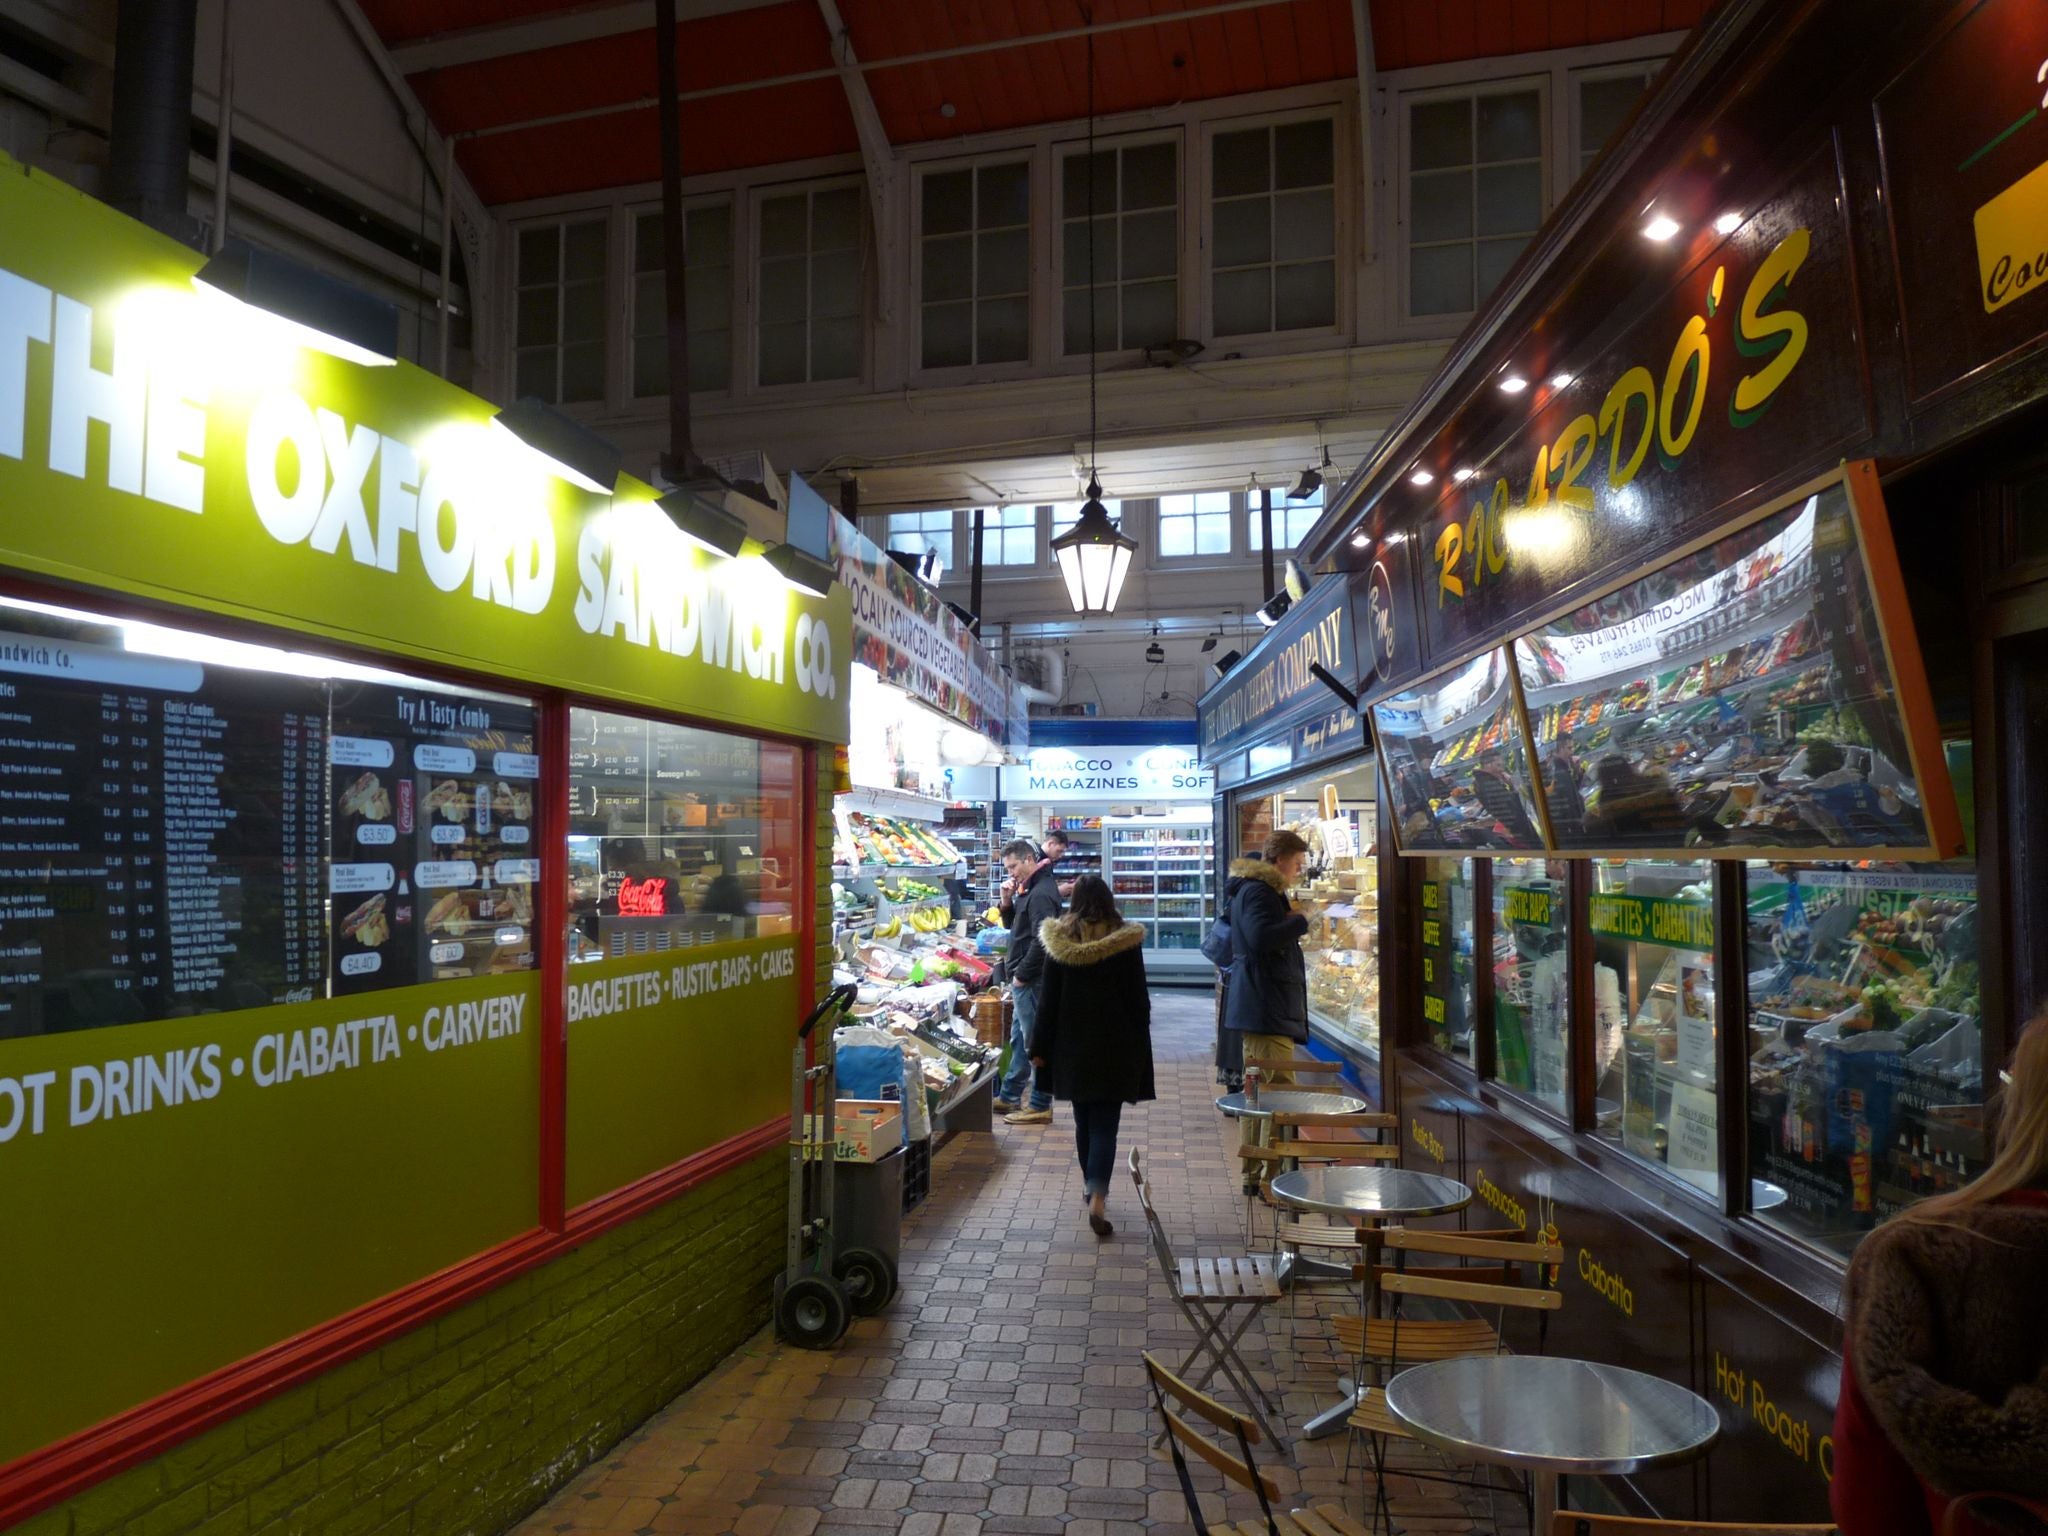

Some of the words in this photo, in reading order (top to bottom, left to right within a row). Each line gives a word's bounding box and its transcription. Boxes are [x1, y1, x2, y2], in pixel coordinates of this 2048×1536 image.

[0, 267, 207, 514] THE
[247, 388, 556, 615] OXFORD
[574, 515, 788, 685] SANDWICH
[795, 611, 835, 699] CO.
[56, 648, 74, 668] Co.
[889, 605, 928, 659] SOURCED
[1244, 659, 1275, 722] CHEESE
[1277, 607, 1341, 700] COMPANY
[398, 696, 415, 725] Try
[419, 699, 426, 721] A
[429, 700, 456, 729] Tasty
[459, 705, 490, 729] Combo
[1029, 776, 1138, 790] MAGAZINES
[1530, 890, 1549, 924] BAPS
[1590, 895, 1643, 937] BAGUETTES
[567, 970, 661, 1022] BAGUETTES
[672, 961, 718, 1000] RUSTIC
[720, 955, 751, 989] BAPS
[760, 947, 795, 981] CAKES
[70, 1044, 221, 1128] DRINKS
[252, 1015, 400, 1087] CIABATTA
[422, 993, 527, 1052] CARVERY
[1476, 1167, 1527, 1231] Cappuccino
[1577, 1247, 1633, 1319] Ciabatta
[1714, 1351, 1747, 1409] Hot
[1751, 1378, 1811, 1464] Roast
